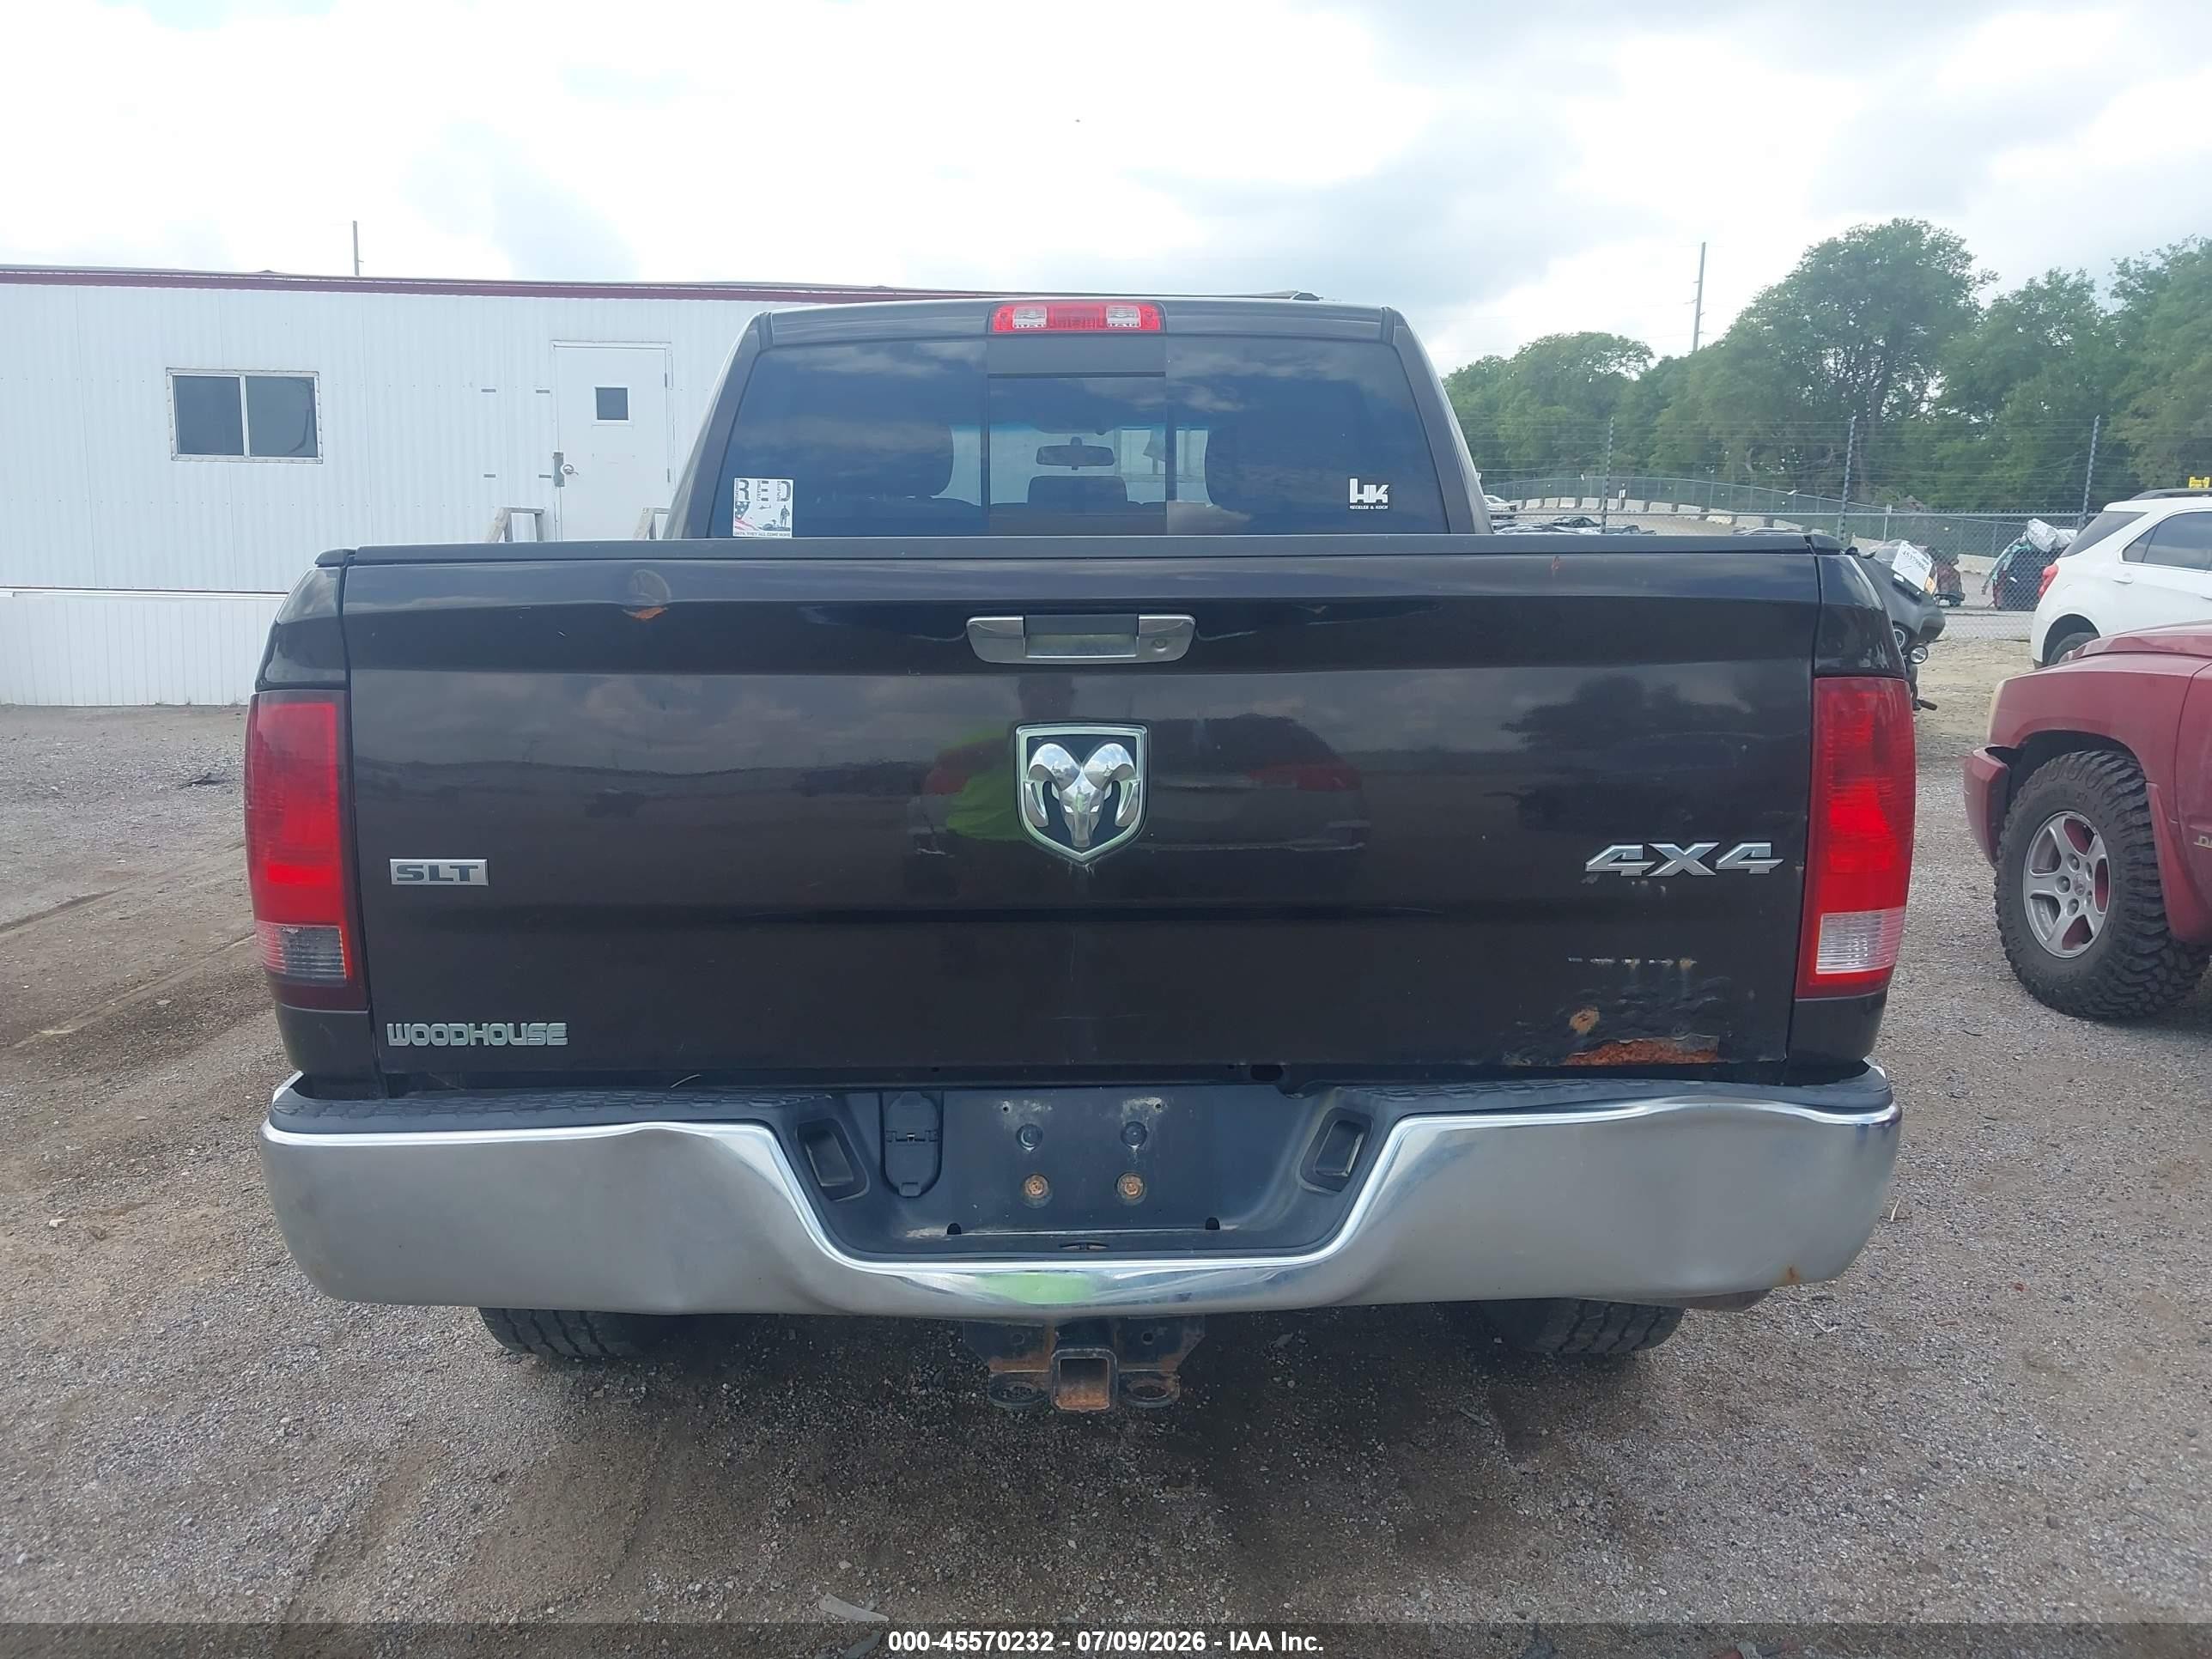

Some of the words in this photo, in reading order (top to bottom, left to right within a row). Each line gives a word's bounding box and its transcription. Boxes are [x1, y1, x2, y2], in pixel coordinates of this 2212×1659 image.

[735, 479, 791, 501] RED
[395, 864, 480, 883] SLT
[386, 1022, 568, 1047] WOODHOUSE
